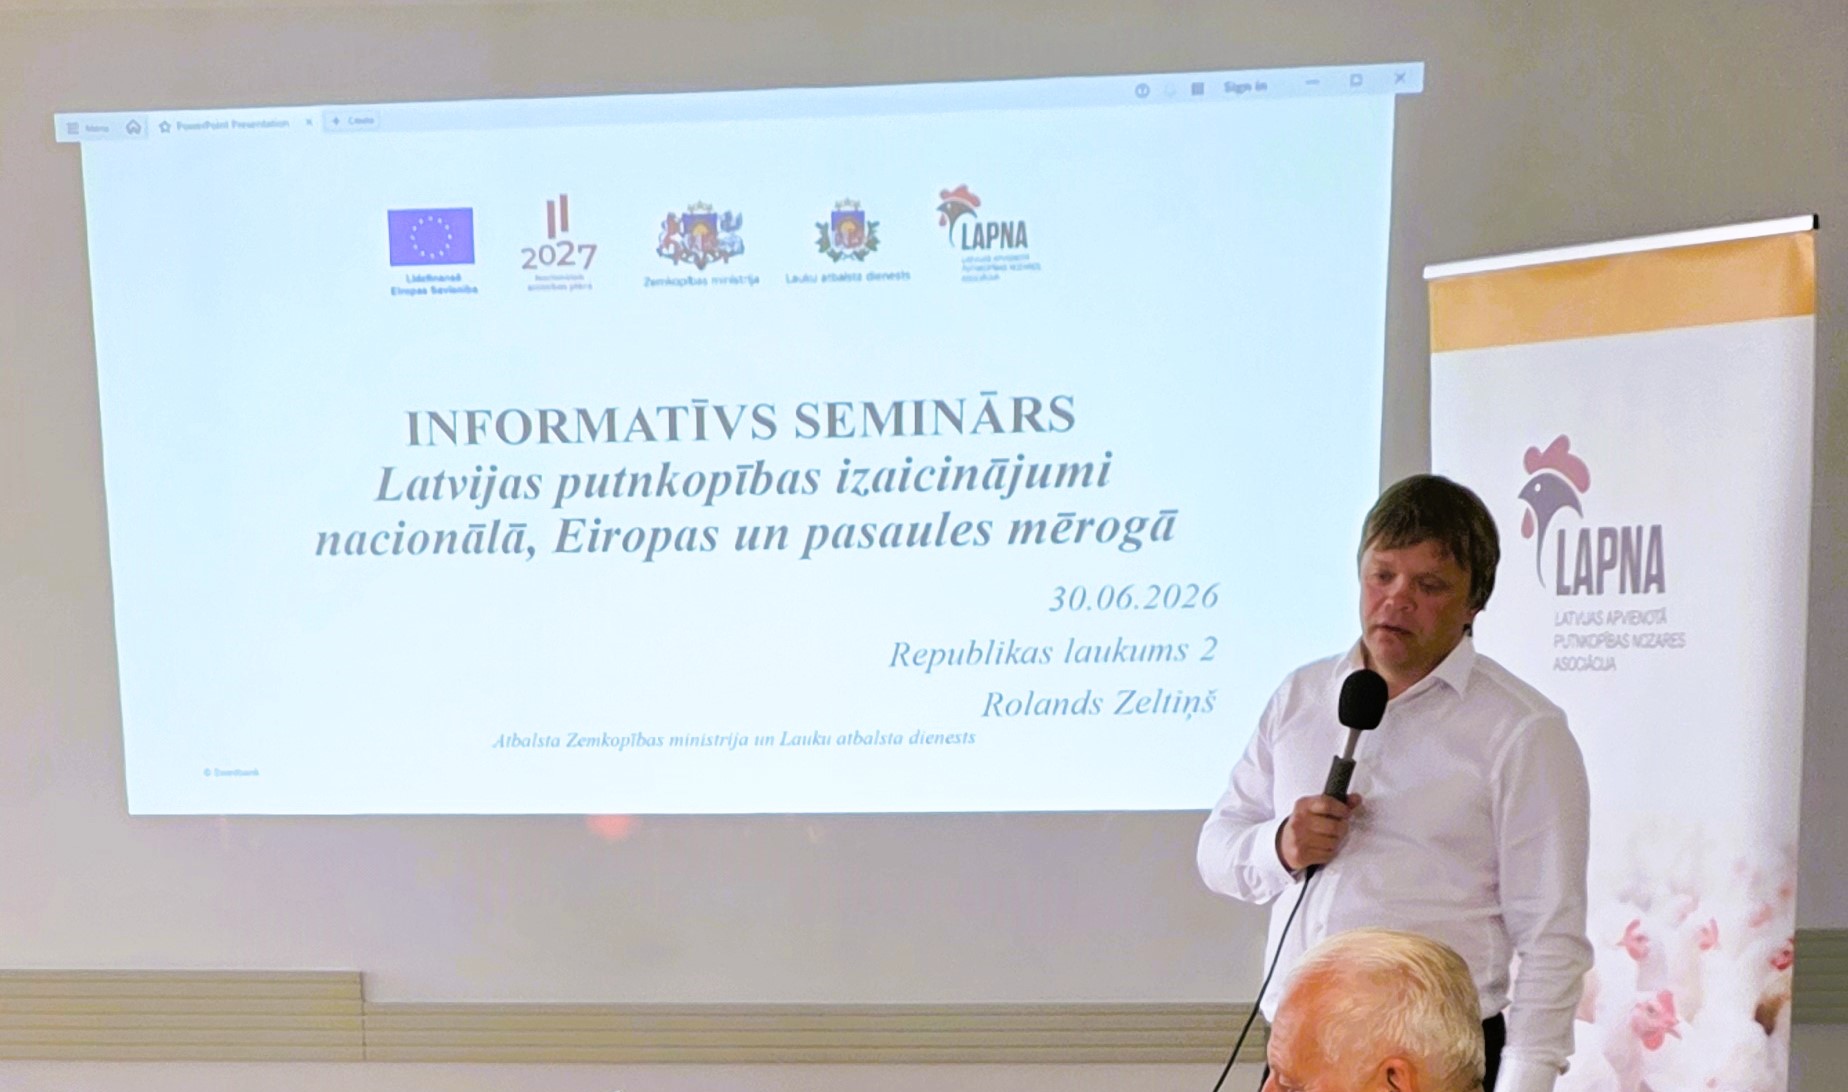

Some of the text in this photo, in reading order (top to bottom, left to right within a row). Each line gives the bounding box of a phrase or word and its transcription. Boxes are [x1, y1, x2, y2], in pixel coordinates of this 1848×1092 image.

[176, 118, 290, 132] PowerPoint Presentation
[961, 220, 1028, 250] LAPNA
[521, 240, 597, 270] 2027
[786, 272, 818, 284] Lauku
[866, 269, 911, 282] dienests
[403, 391, 1076, 447] INFORMATĪVS SEMINĀRS
[374, 451, 1113, 510] Latvijas putnkopības izaicinājumi
[315, 509, 1179, 562] nacionālā, Eiropas un pasaules mērogā
[1556, 524, 1666, 596] LAPNA
[1048, 582, 1221, 612] 30.06.2026
[1554, 610, 1604, 627] LATVIJAS
[888, 635, 1218, 674] Republikas laukums 2
[1553, 631, 1687, 650] PUTNKOPĪBAS NOZARES
[1553, 654, 1617, 672] ASOCIĀCIJA
[981, 688, 1219, 721] Rolands Zeltiņš
[491, 728, 977, 752] Atbalsta Zemkopības ministrija un Lauku atbalsta dienests
